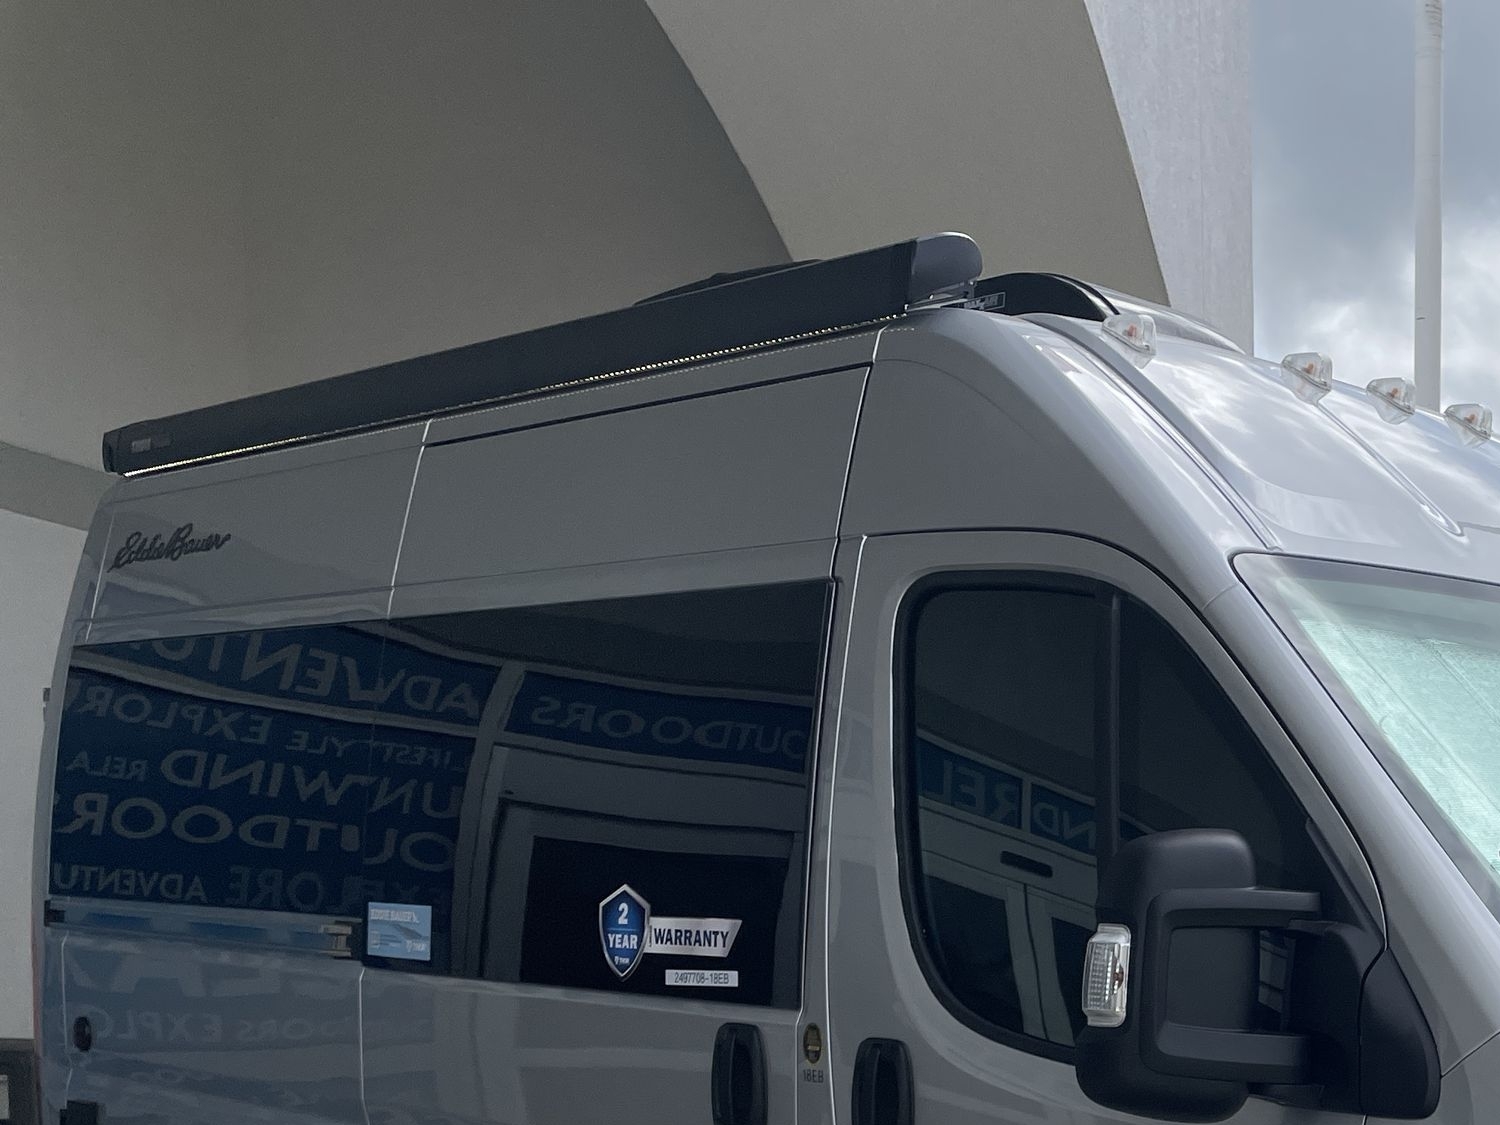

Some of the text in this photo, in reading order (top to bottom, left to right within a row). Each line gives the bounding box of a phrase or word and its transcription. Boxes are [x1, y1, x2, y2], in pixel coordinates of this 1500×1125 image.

[164, 523, 232, 561] Bauer
[618, 902, 629, 925] 2
[607, 933, 638, 950] YEAR
[653, 928, 730, 948] WARRANTY
[802, 1068, 824, 1084] 18EB
